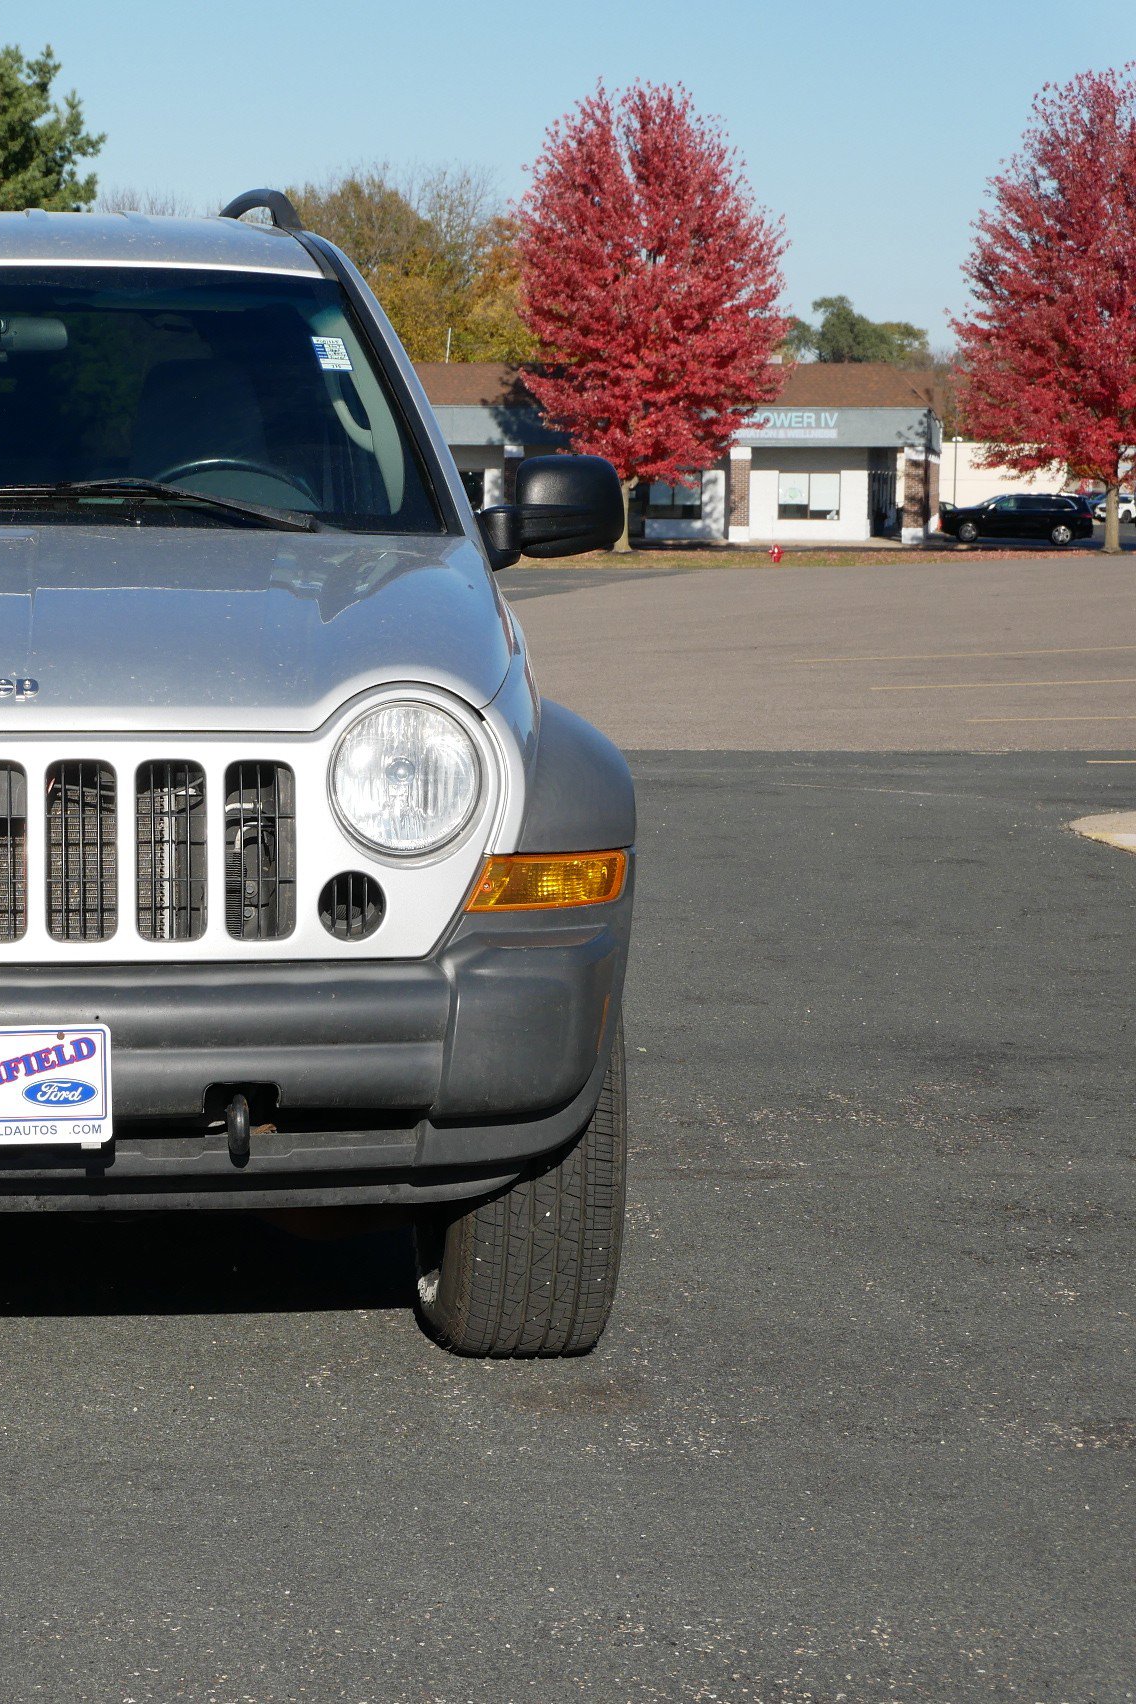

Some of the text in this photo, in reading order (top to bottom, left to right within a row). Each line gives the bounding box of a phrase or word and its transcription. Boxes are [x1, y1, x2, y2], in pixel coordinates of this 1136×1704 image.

[820, 412, 838, 427] IV
[37, 1083, 83, 1101] Ford
[69, 1124, 102, 1135] .COM
